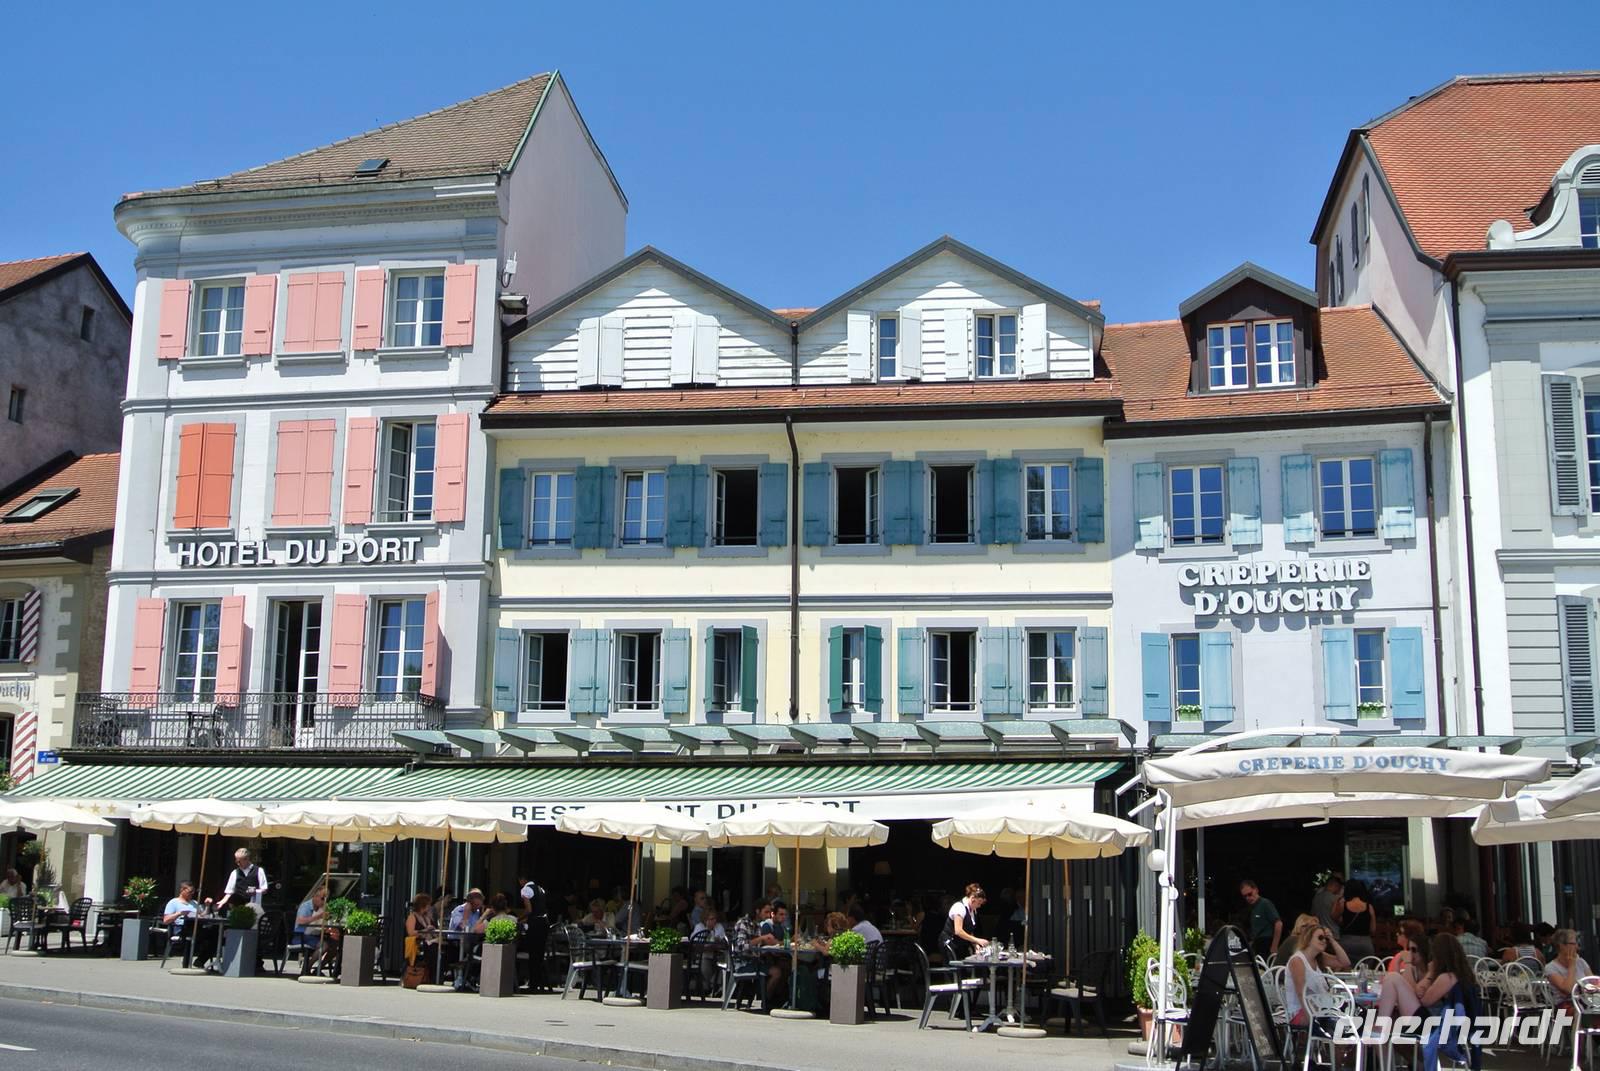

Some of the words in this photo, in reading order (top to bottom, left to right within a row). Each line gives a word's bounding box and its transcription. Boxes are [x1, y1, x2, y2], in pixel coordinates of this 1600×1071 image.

[177, 541, 274, 566] HOTEL
[285, 539, 326, 564] DU
[340, 537, 421, 563] PORT
[1178, 557, 1371, 587] CREPERIE
[1194, 586, 1359, 615] D'OUCHY
[1238, 756, 1345, 773] CREPERIE
[1353, 755, 1451, 771] D'OUCHY
